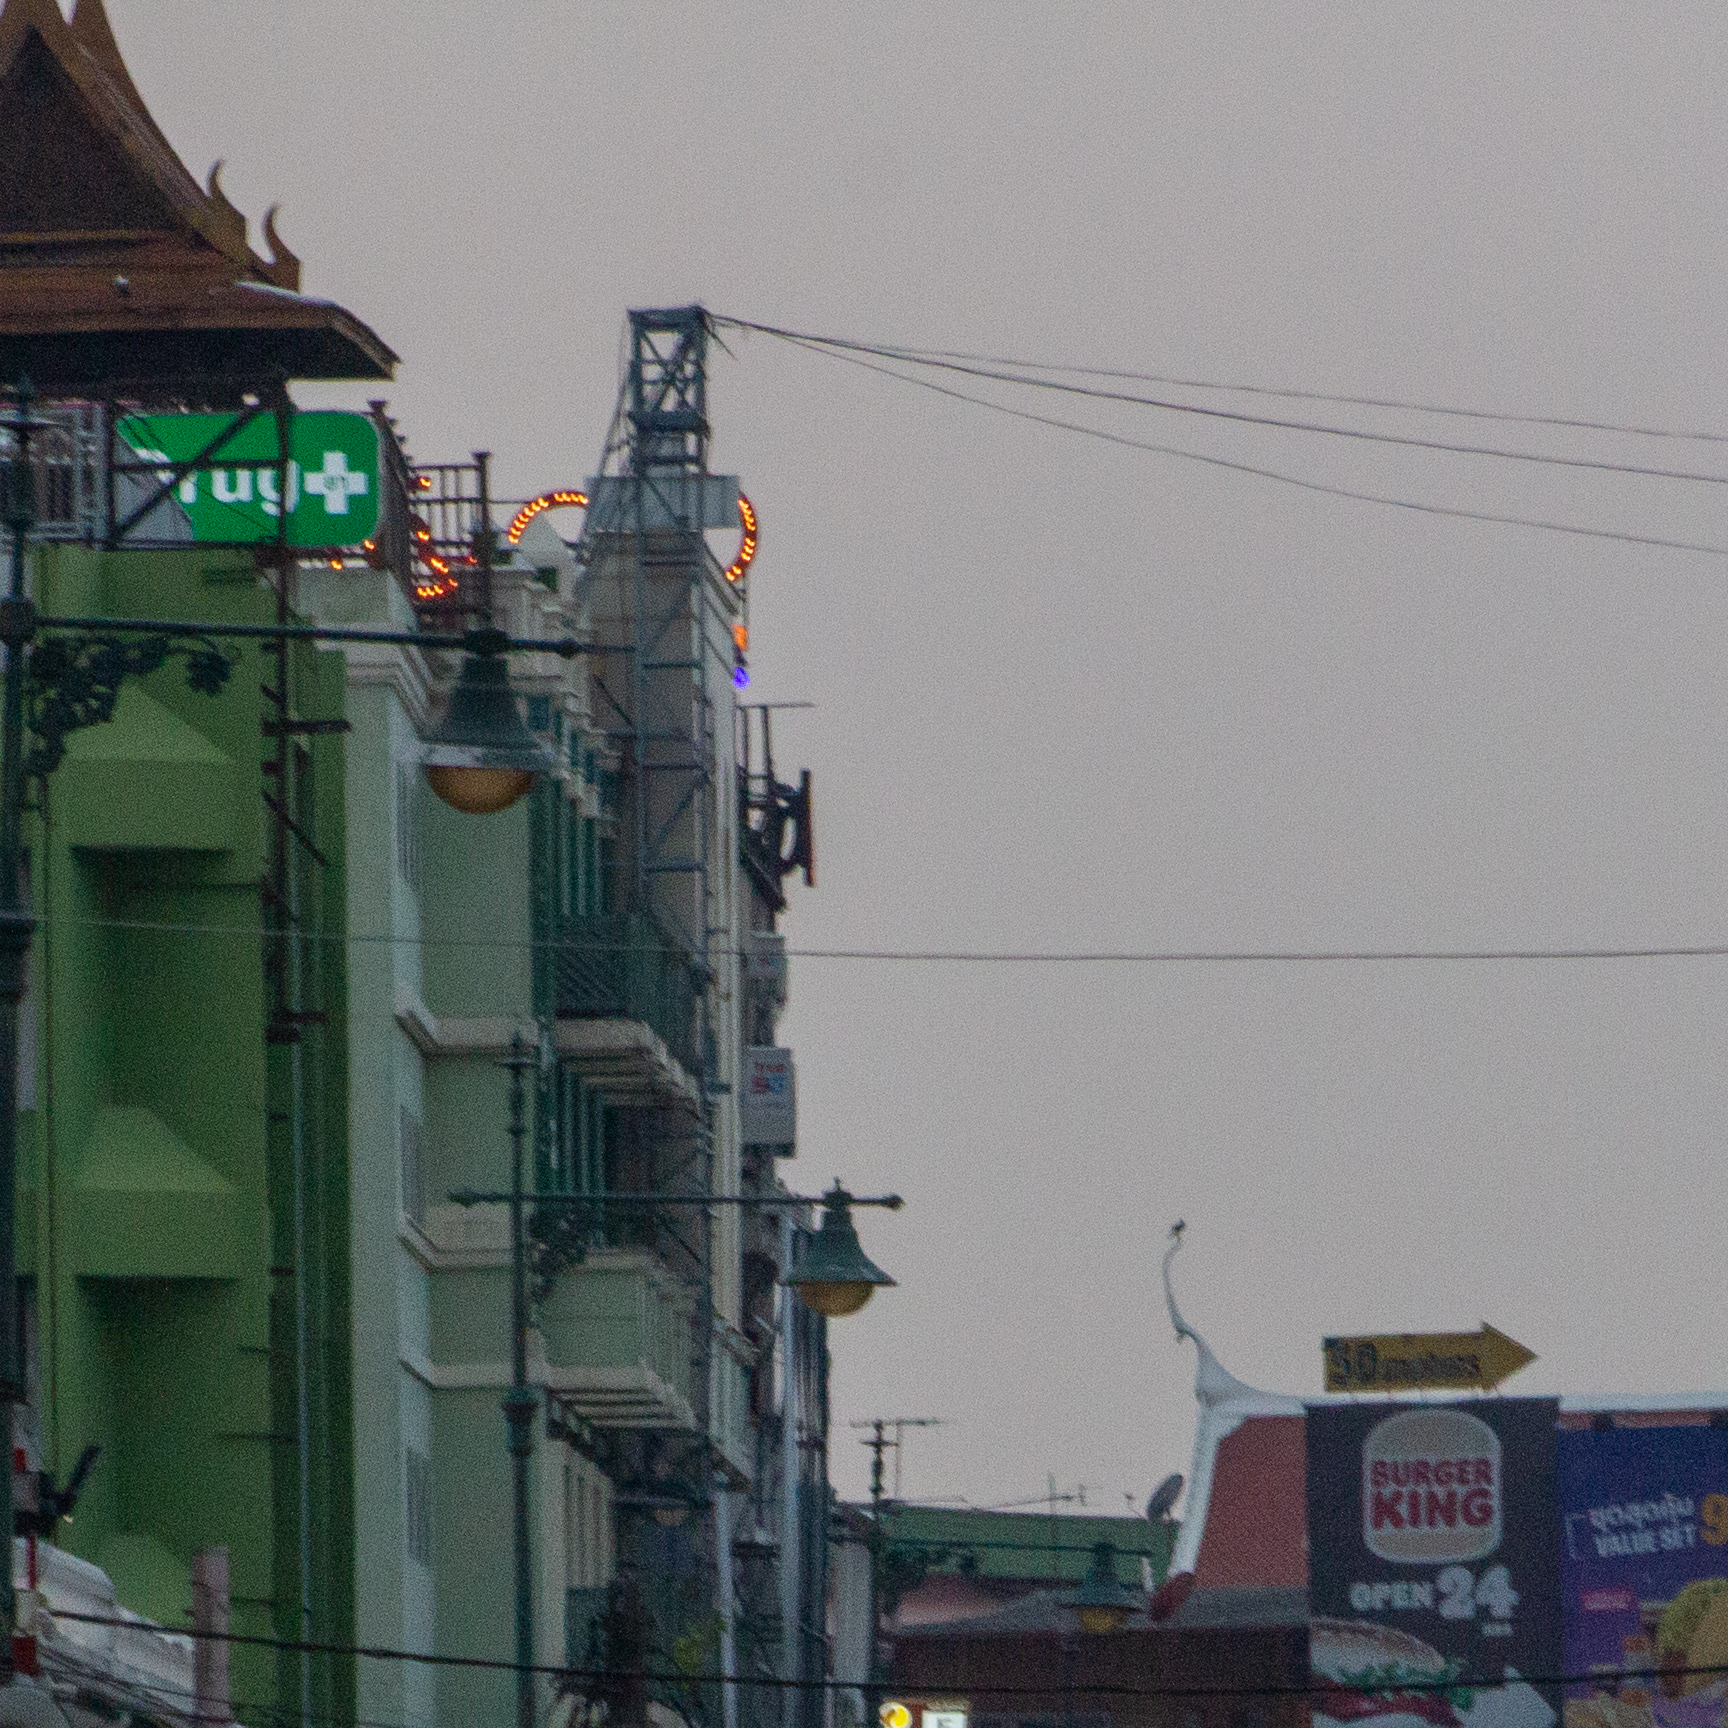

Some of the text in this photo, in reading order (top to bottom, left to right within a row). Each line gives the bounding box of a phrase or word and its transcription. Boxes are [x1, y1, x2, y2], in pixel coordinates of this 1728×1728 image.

[1370, 1458, 1494, 1488] BURGER
[1371, 1488, 1495, 1531] KING
[1349, 1565, 1520, 1621] OPEN 24
